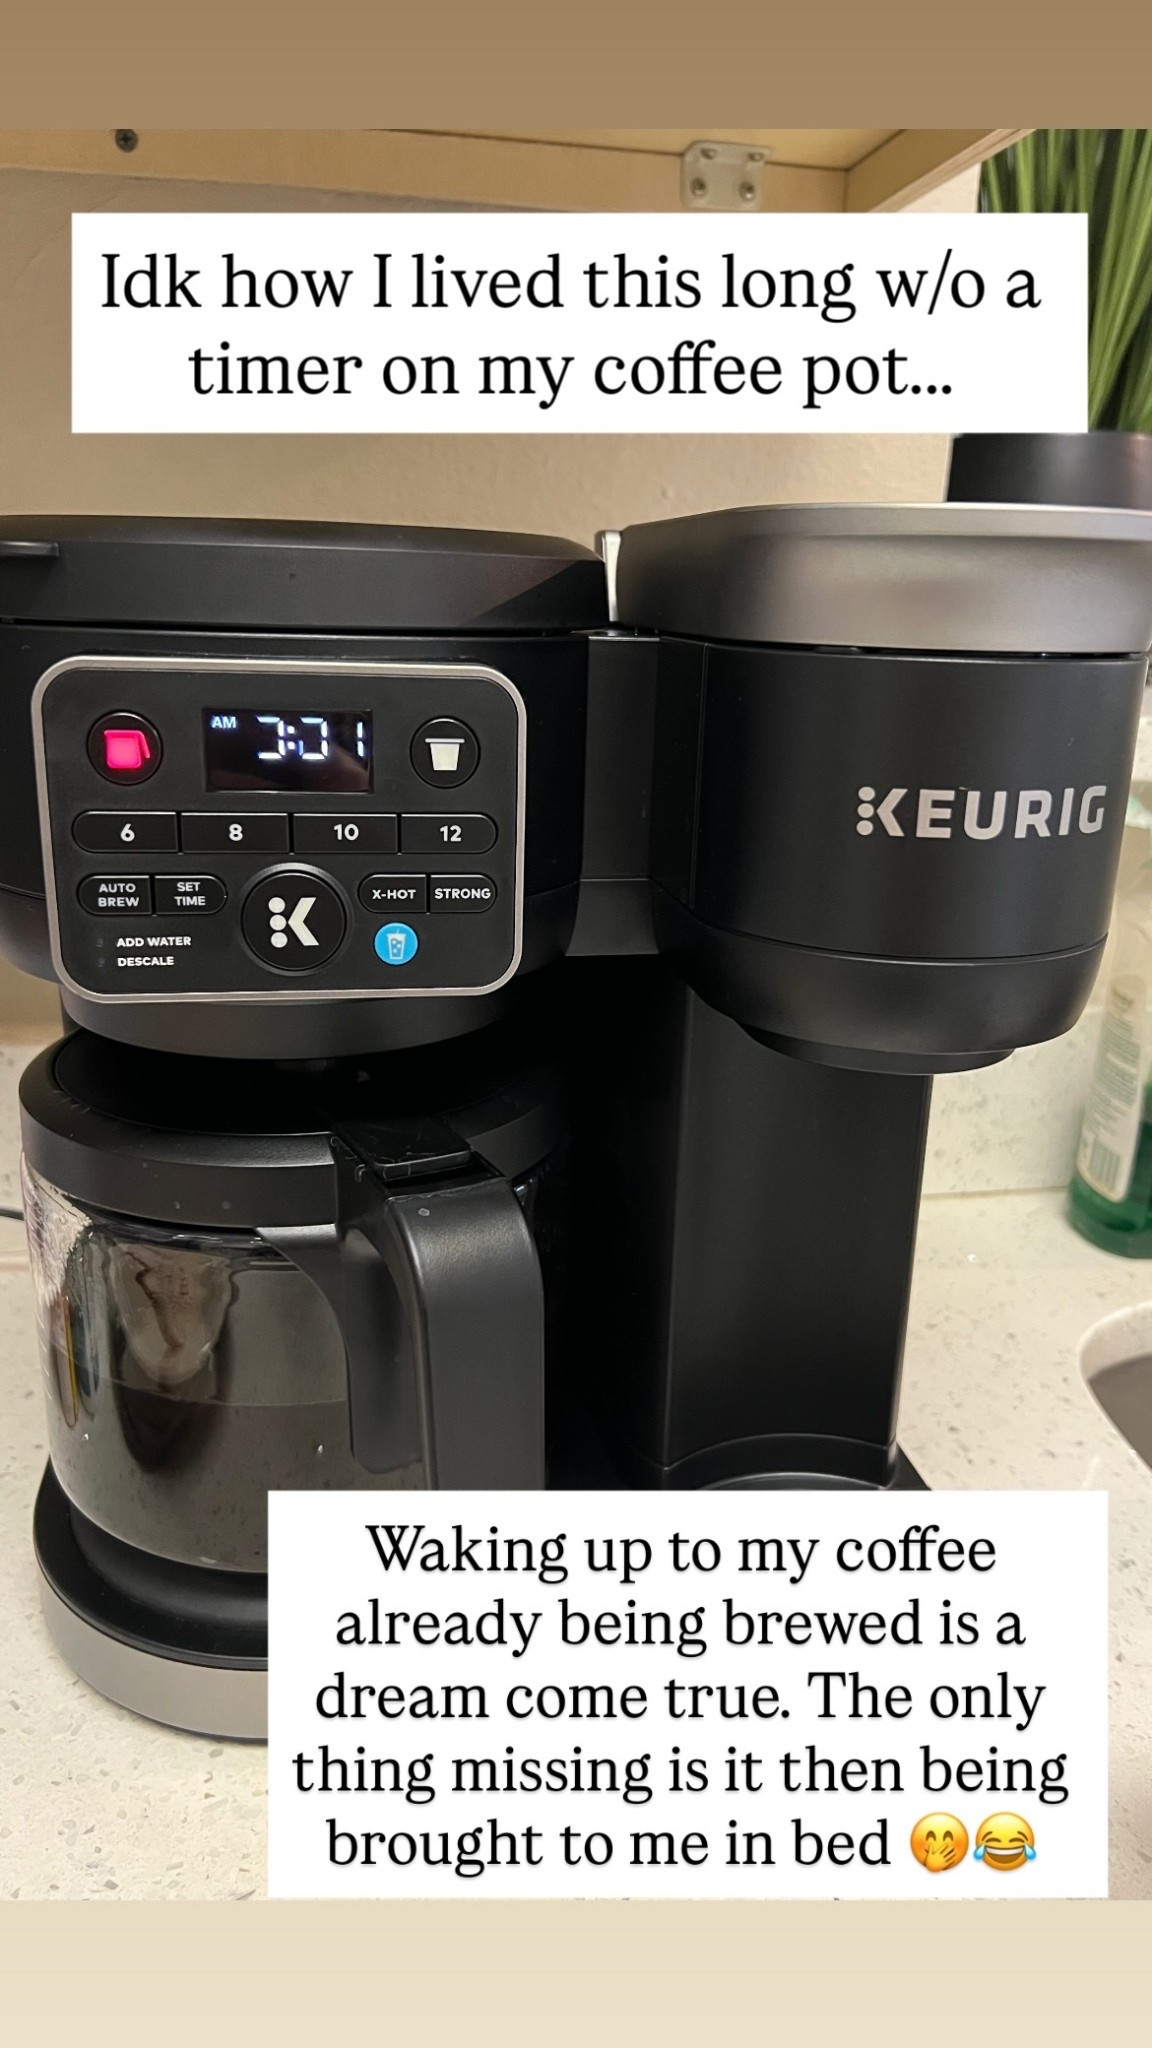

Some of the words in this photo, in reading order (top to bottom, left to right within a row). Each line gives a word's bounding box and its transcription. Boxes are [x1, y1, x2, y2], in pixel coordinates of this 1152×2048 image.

[211, 715, 237, 729] AM
[856, 785, 1107, 840] KEURIG
[120, 823, 135, 842] 6
[229, 823, 243, 842] 8
[333, 823, 359, 841] 10
[439, 824, 462, 842] 12
[98, 882, 136, 893] AUTO
[176, 881, 201, 892] SET
[372, 888, 417, 900] X-HOT
[434, 887, 491, 900] STRONG
[98, 896, 140, 907] BREW
[175, 895, 206, 906] TIME
[116, 937, 143, 948] ADD
[147, 936, 192, 947] WATER
[117, 956, 174, 967] DESCALE
